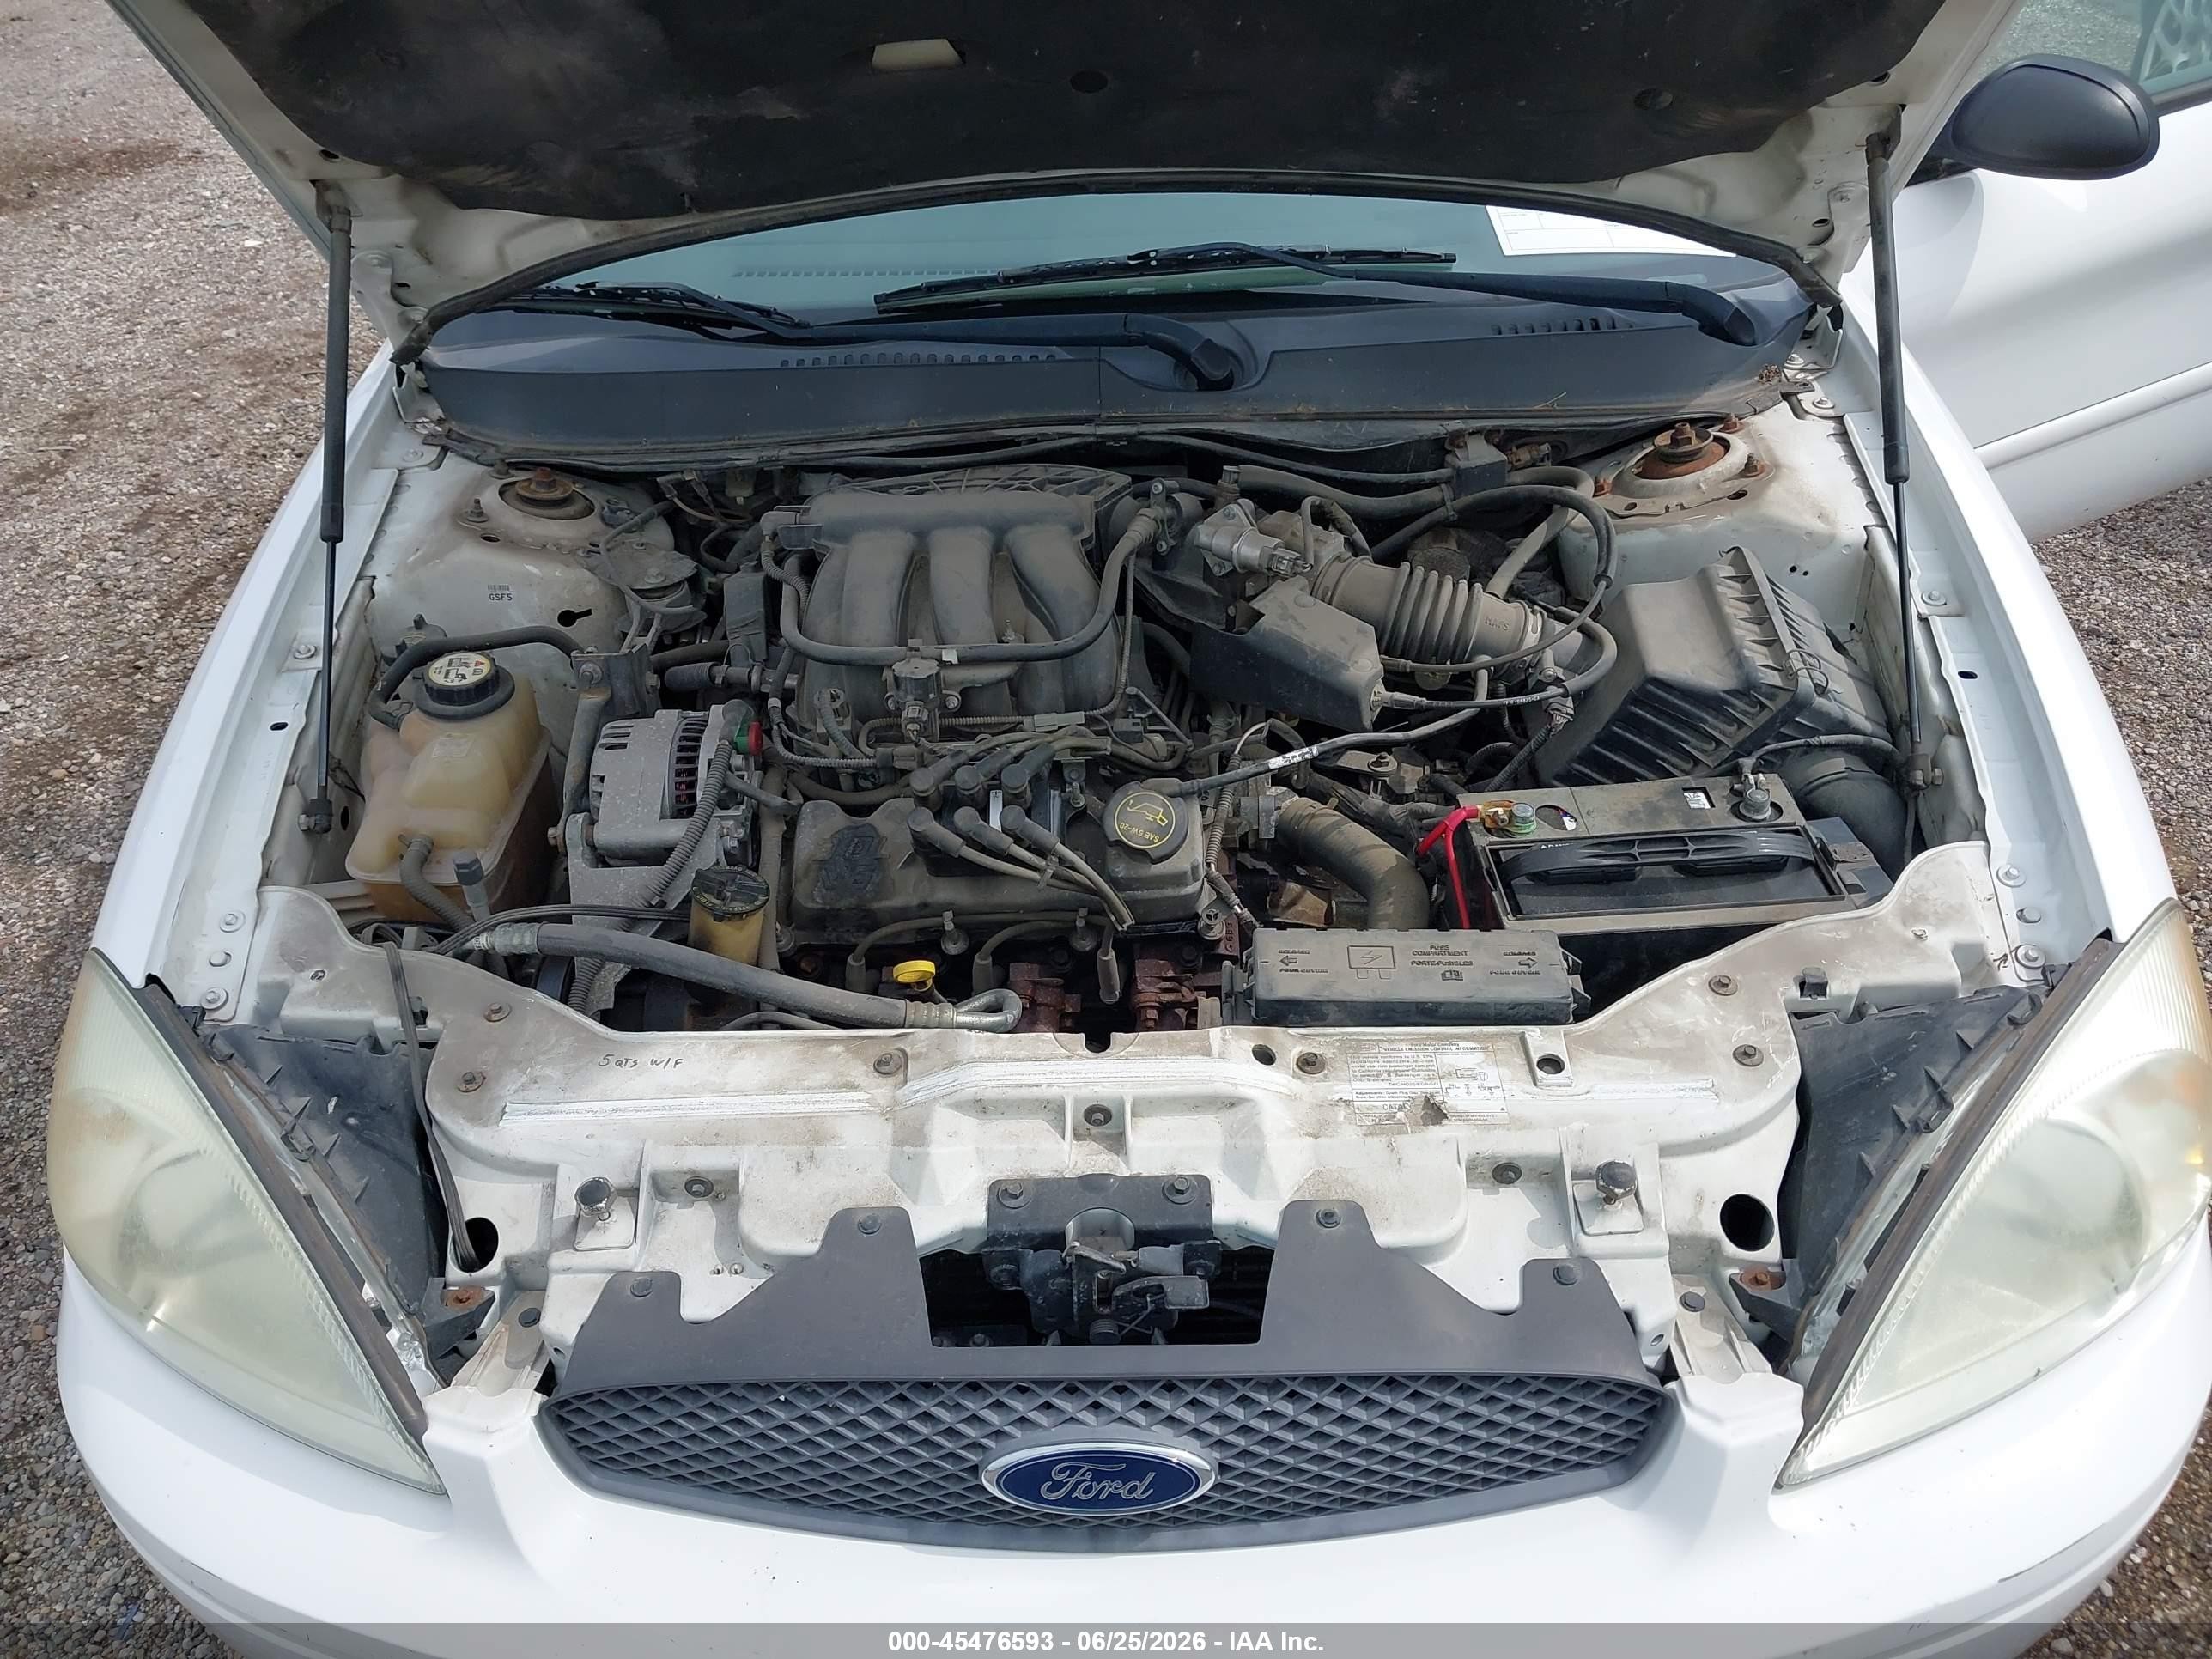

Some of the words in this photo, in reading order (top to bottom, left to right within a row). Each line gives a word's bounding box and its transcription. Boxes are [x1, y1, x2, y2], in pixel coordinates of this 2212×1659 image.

[1119, 822, 1144, 837] 5W-20
[1144, 830, 1160, 842] SAE
[1039, 1462, 1157, 1501] Ford
